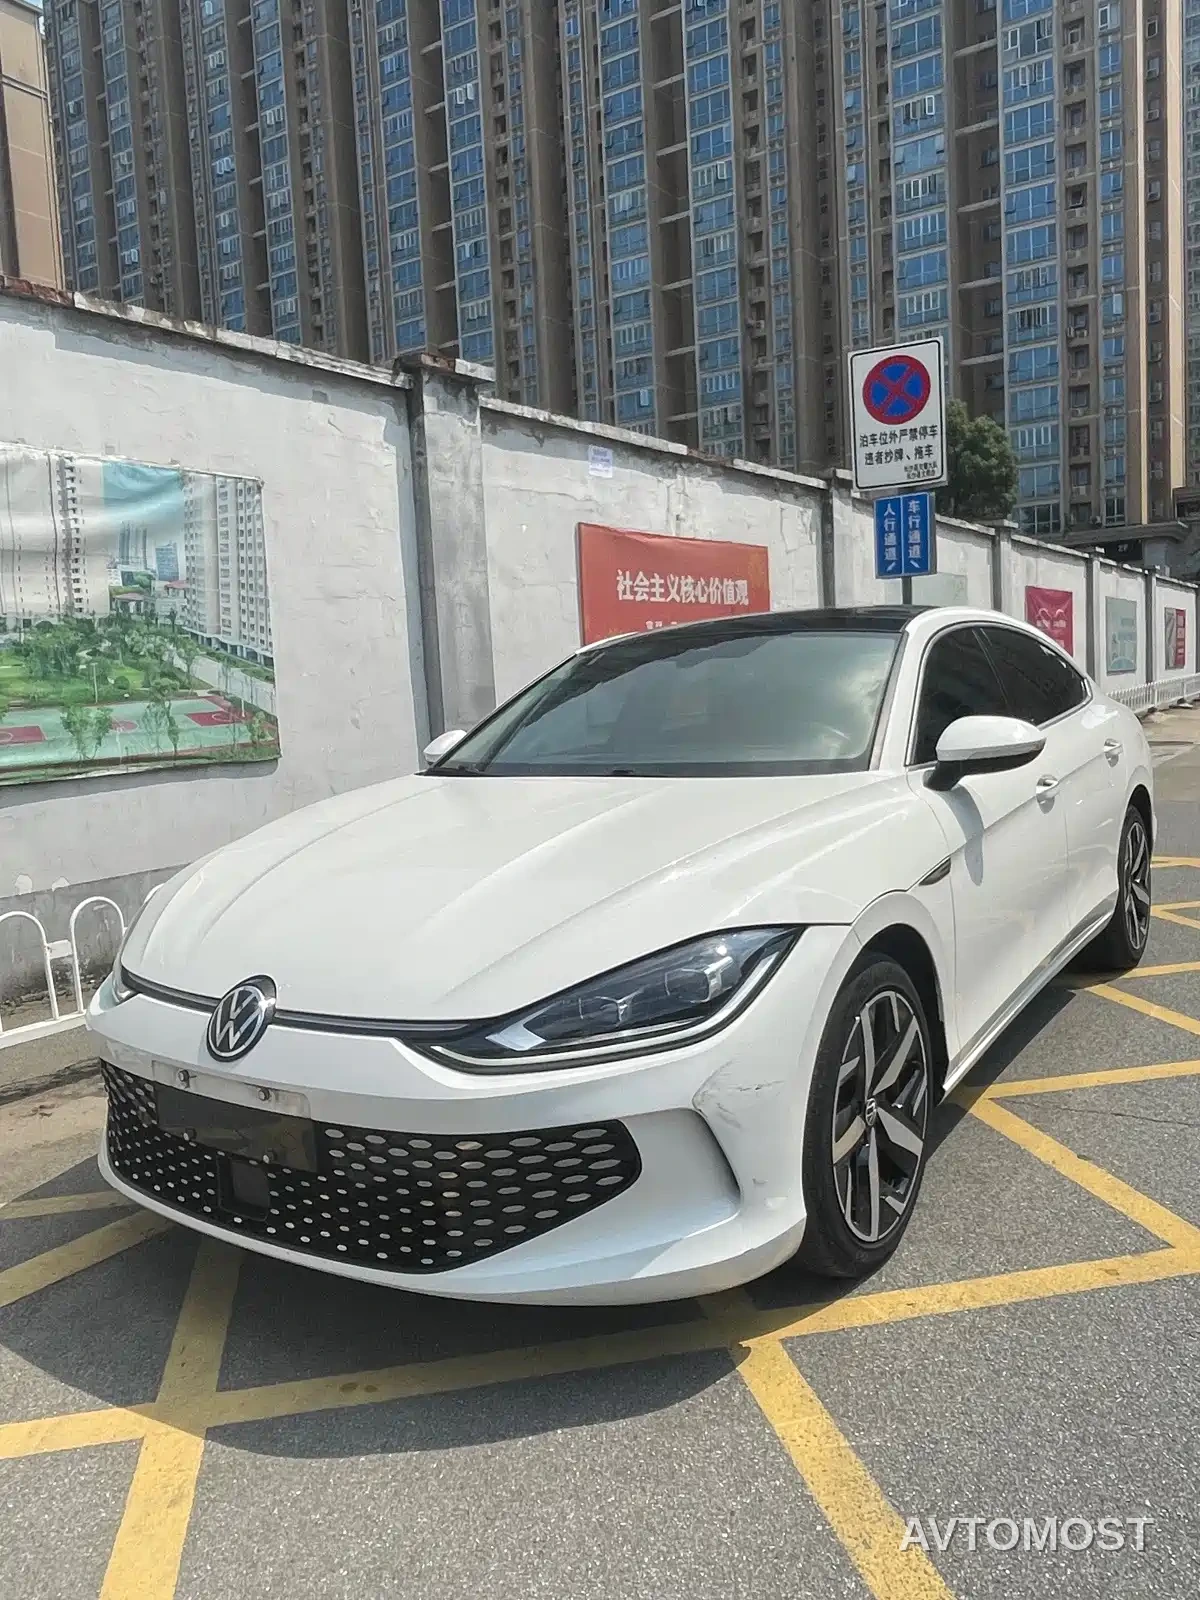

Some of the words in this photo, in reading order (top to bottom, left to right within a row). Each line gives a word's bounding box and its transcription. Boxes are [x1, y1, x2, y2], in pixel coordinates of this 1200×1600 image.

[859, 424, 938, 448] 泊车位外严禁停车
[864, 444, 934, 466] 违者抄牌、拖车
[883, 502, 897, 560] 人行通道
[908, 499, 921, 558] 车行通道
[616, 569, 749, 606] 社会主义核心价值观
